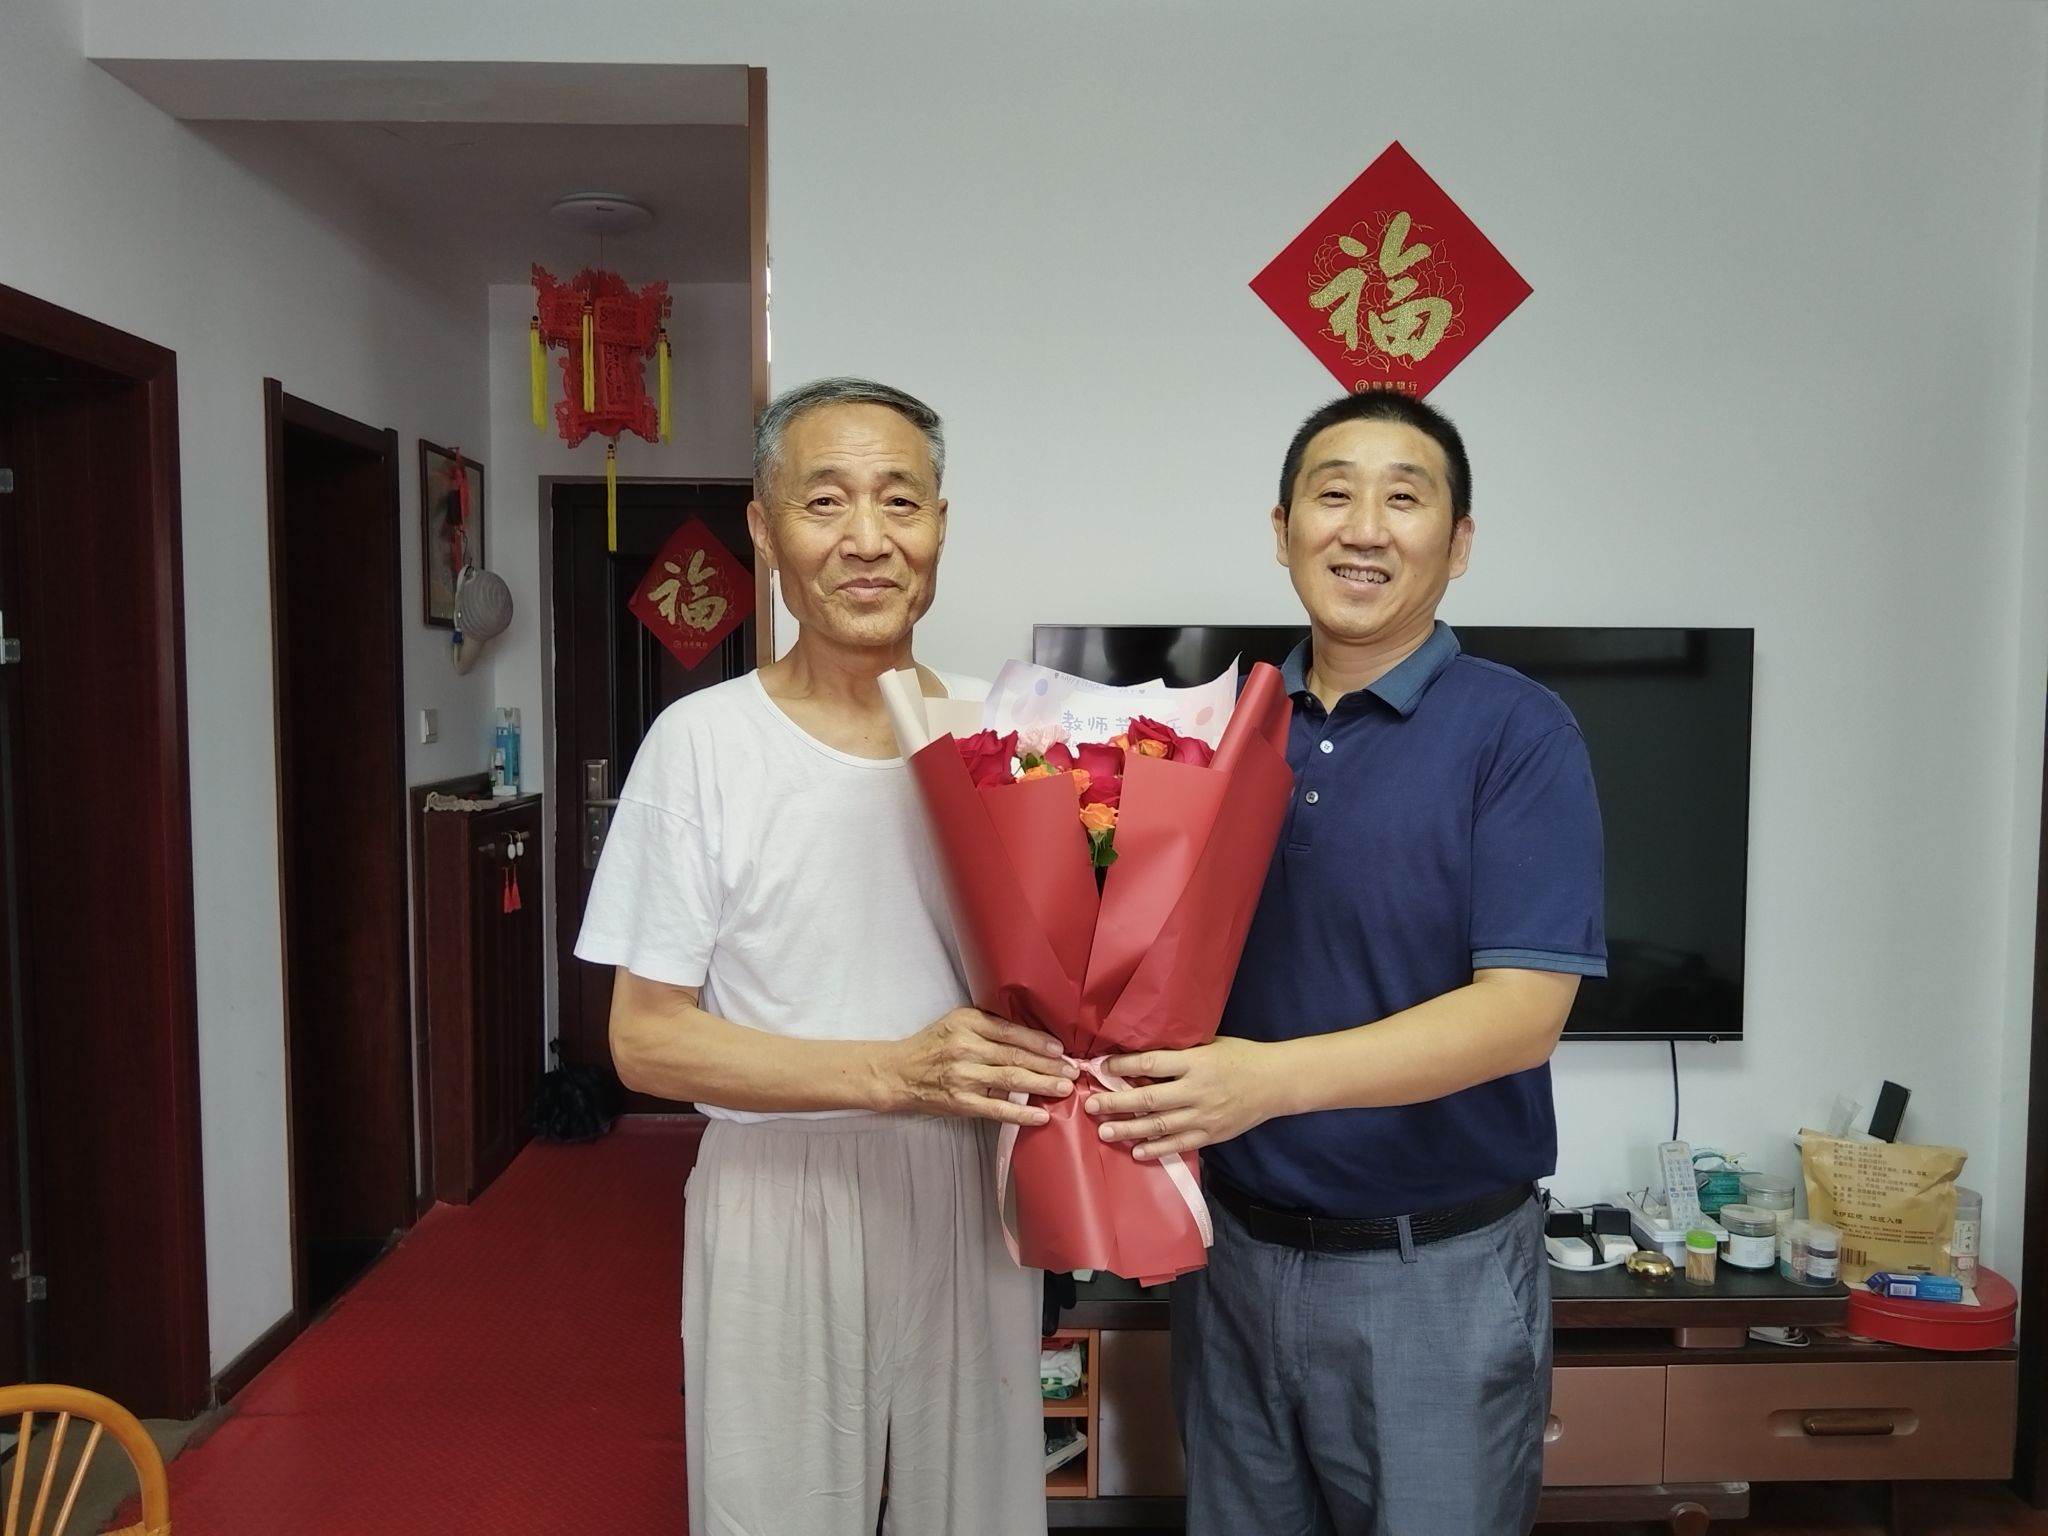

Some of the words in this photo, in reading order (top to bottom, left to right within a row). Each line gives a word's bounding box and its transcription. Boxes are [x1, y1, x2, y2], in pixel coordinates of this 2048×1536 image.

[1308, 211, 1453, 361] 福
[647, 549, 727, 632] 福
[1062, 710, 1183, 735] 教师节乐
